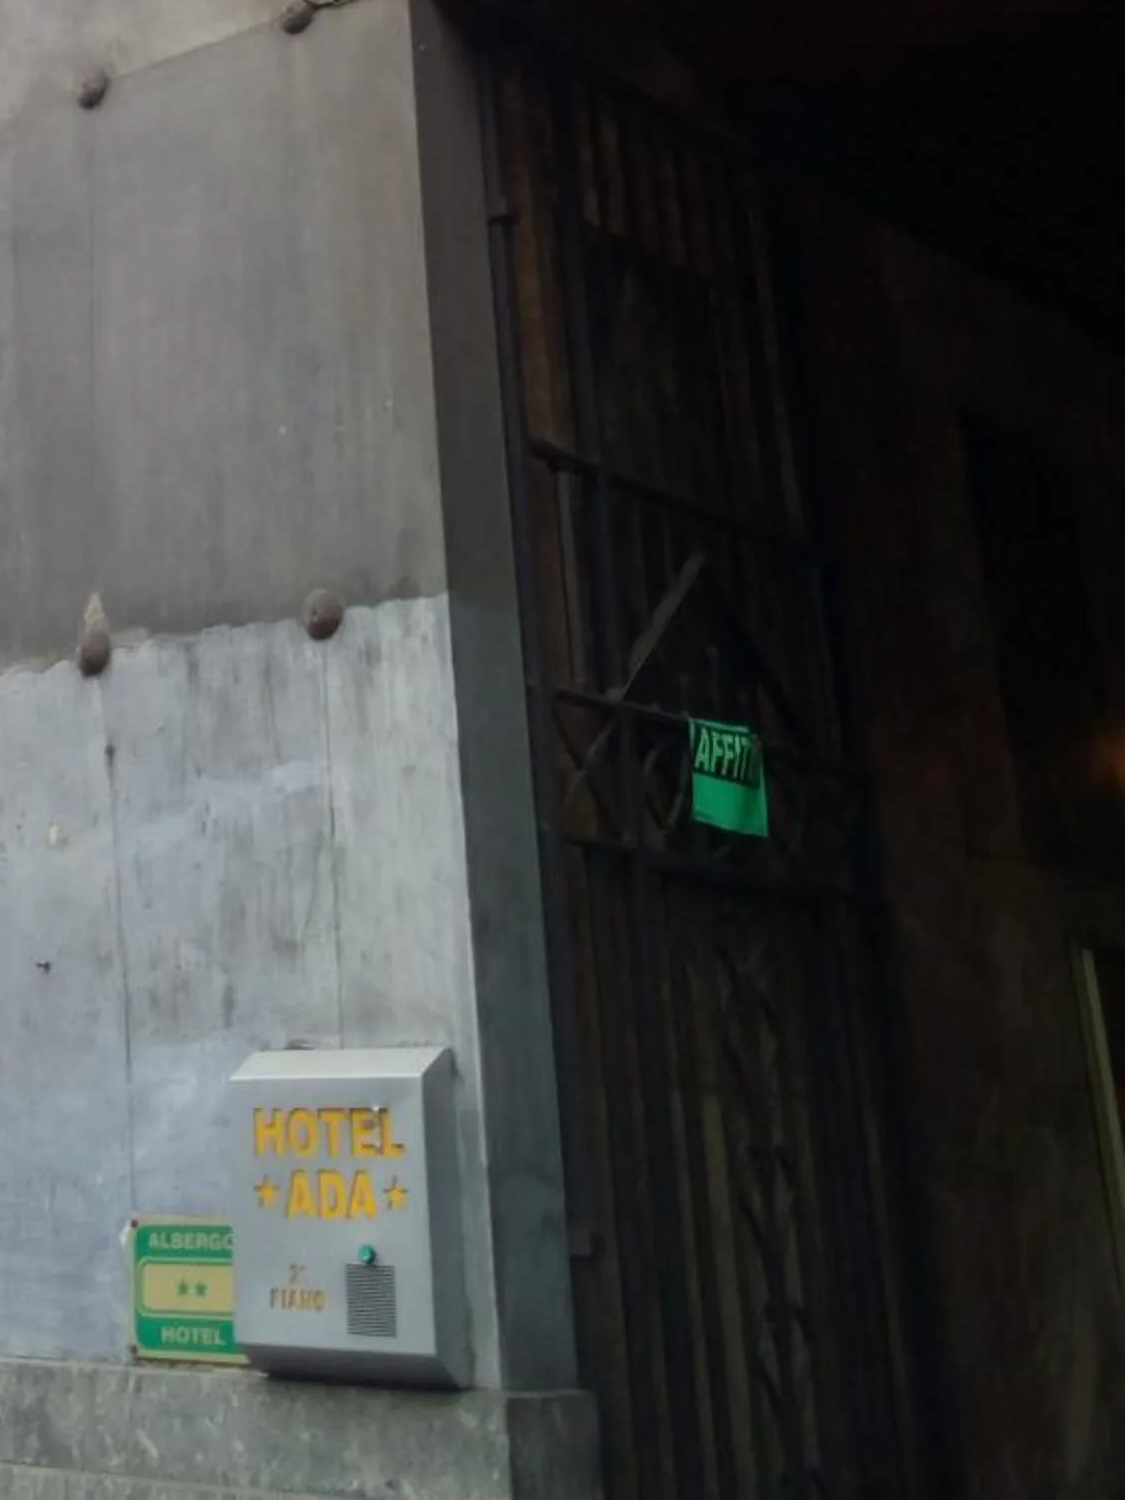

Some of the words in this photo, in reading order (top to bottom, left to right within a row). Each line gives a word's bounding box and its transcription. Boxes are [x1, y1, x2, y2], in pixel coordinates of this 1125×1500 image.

[251, 1106, 407, 1158] HOTEL
[285, 1168, 378, 1220] ADA
[160, 1326, 228, 1346] HOTEL
